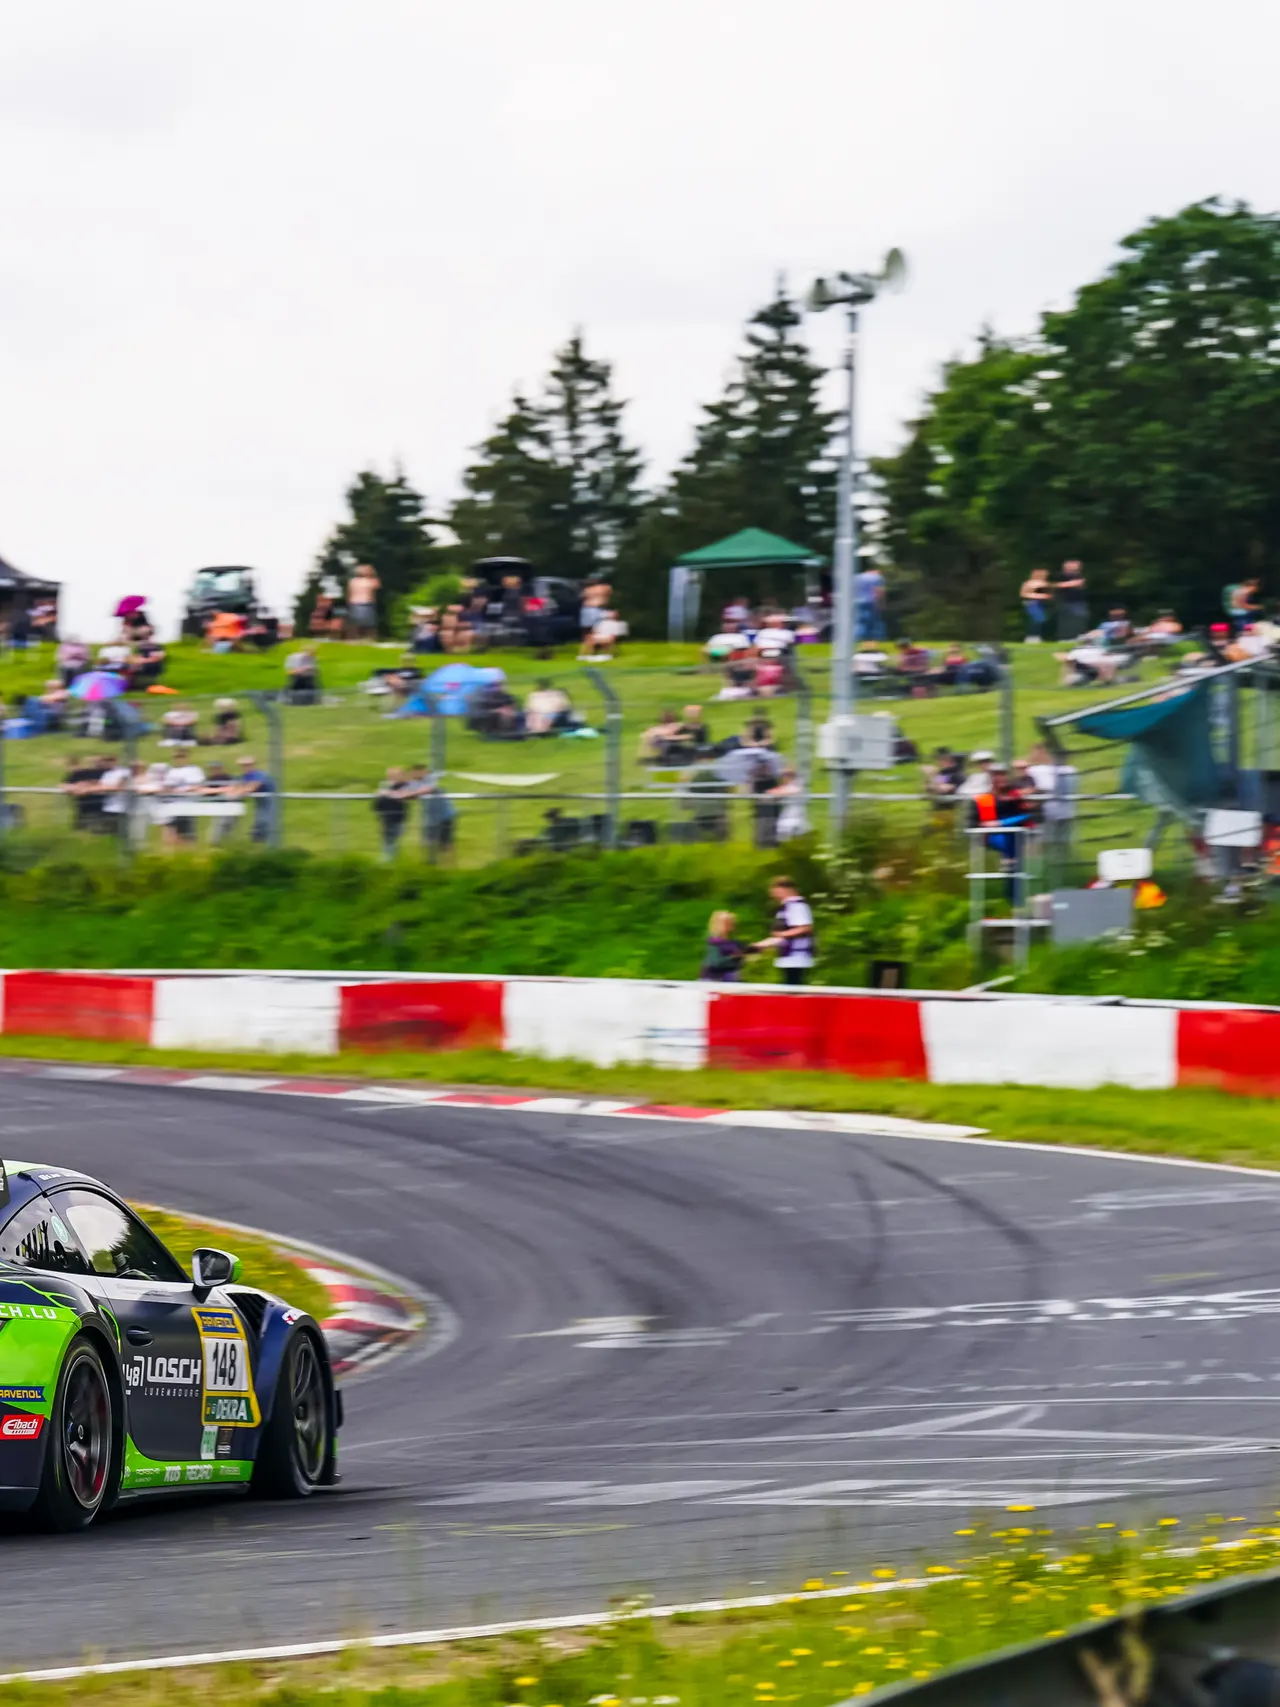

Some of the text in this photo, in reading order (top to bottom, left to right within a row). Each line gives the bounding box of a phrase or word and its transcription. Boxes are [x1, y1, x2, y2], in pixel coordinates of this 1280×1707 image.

[146, 1356, 202, 1385] LOSCH
[213, 1342, 237, 1386] 148
[2, 1418, 39, 1435] Eibach
